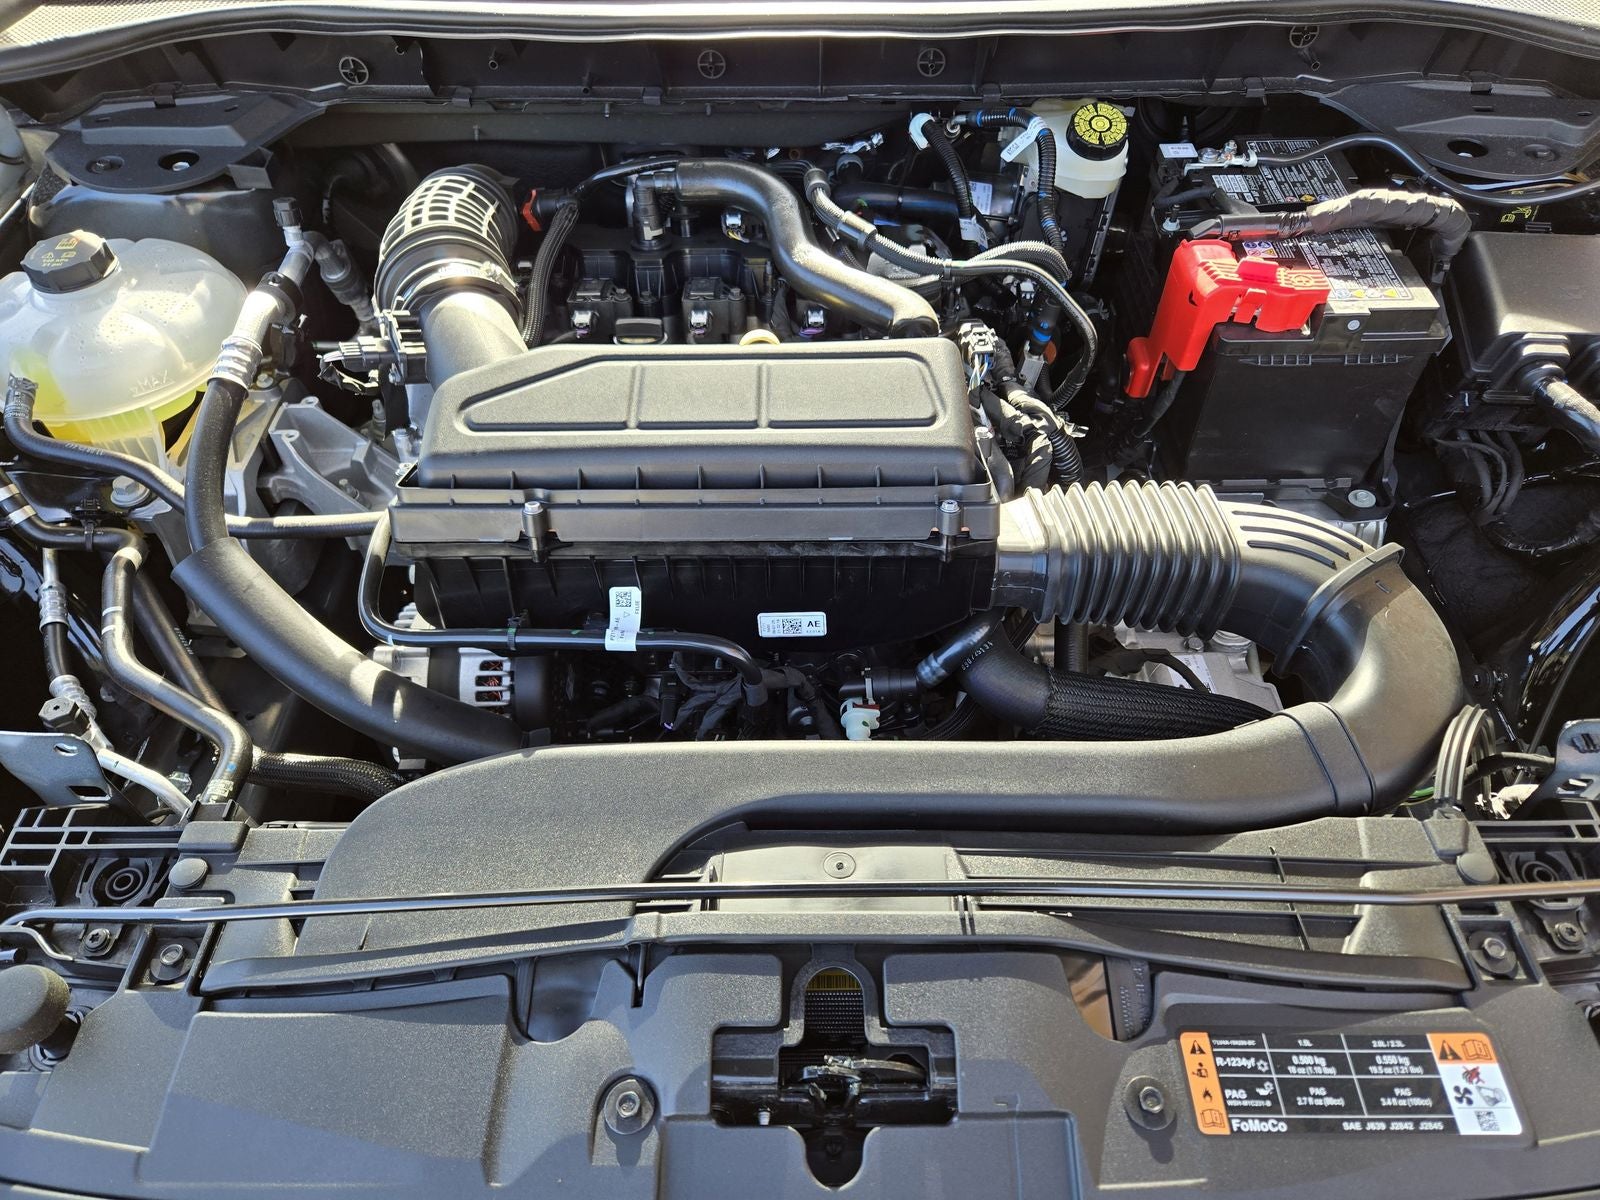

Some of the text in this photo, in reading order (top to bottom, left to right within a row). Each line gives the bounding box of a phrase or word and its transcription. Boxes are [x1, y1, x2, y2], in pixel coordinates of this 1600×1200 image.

[807, 620, 821, 628] AE
[1215, 1056, 1255, 1069] R-1234yf
[1314, 1055, 1327, 1067] kg
[1398, 1055, 1411, 1067] kg
[1224, 1089, 1247, 1099] PAG
[1308, 1086, 1327, 1096] PAG
[1393, 1087, 1412, 1097] PAG
[1231, 1118, 1288, 1132] FoMoCo
[1342, 1121, 1363, 1131] SAE
[1365, 1121, 1387, 1131] J639
